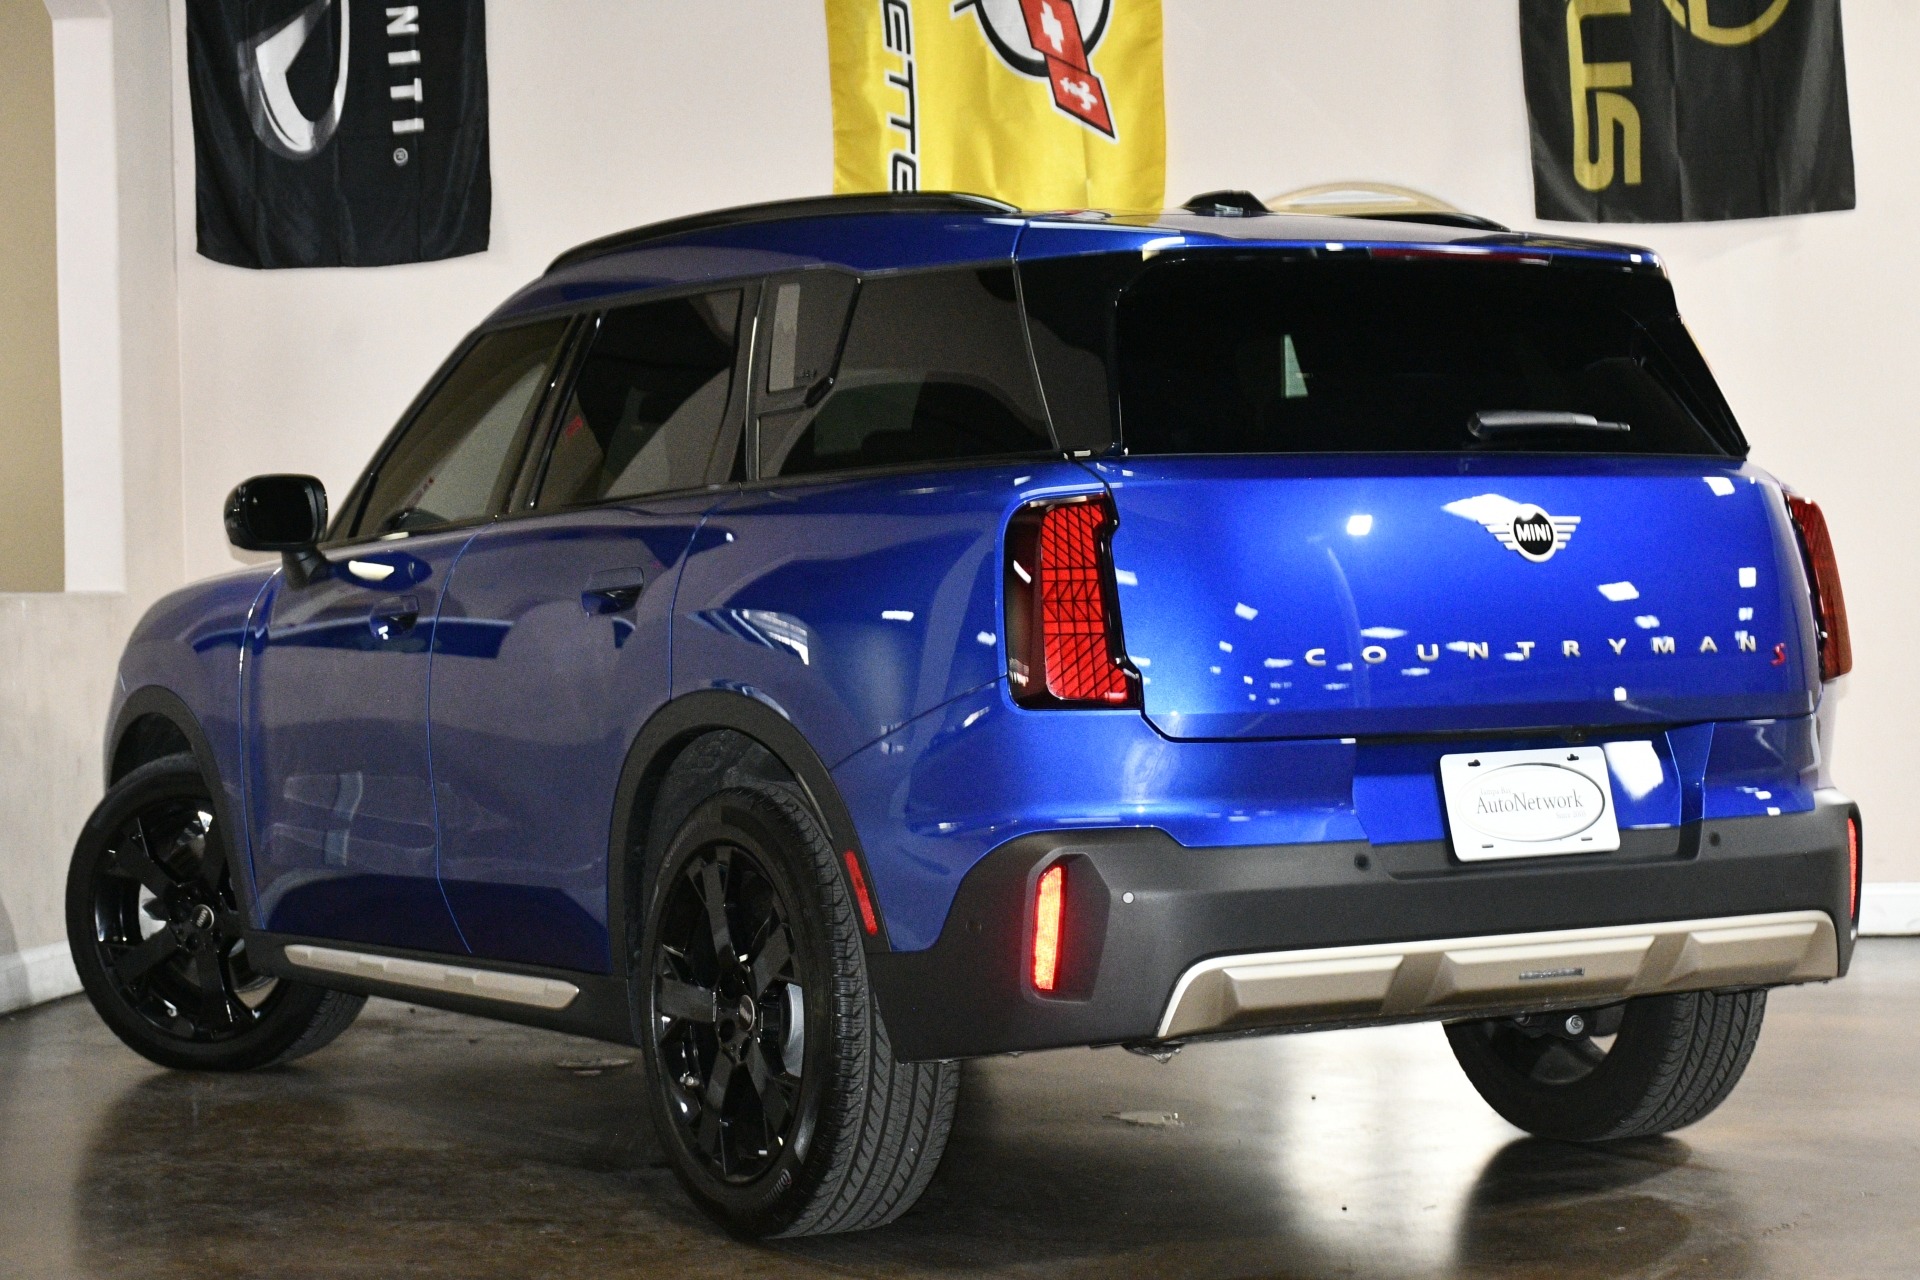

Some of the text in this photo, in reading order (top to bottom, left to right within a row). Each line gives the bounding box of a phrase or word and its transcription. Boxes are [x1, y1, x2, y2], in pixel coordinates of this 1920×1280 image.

[1565, 0, 1642, 191] US
[1515, 523, 1552, 542] MINI
[1303, 634, 1786, 667] COUNTRYMAN S
[1476, 788, 1584, 815] AutoNetwork
